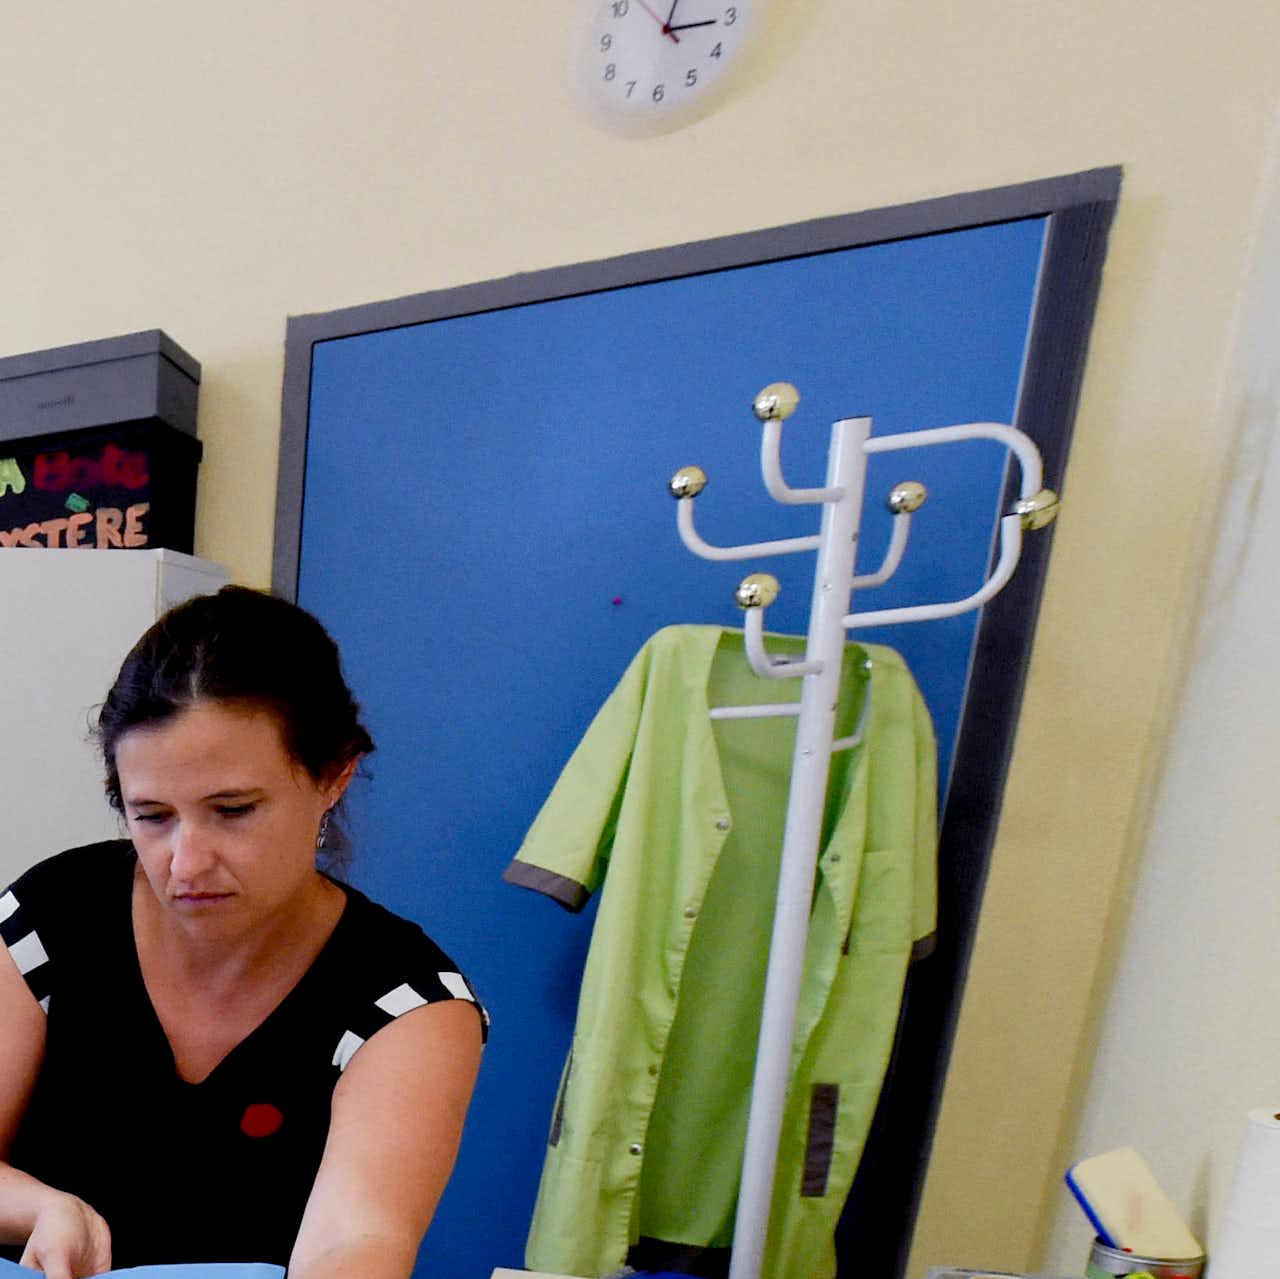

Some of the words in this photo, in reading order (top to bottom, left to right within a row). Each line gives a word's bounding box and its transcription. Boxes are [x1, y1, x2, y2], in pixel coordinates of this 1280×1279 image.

[611, 2, 629, 19] 10
[724, 7, 736, 26] 3
[600, 33, 612, 52] 9
[710, 42, 722, 59] 4
[604, 64, 616, 81] 8
[685, 69, 697, 87] 5
[625, 81, 636, 98] 7
[652, 84, 664, 102] 6
